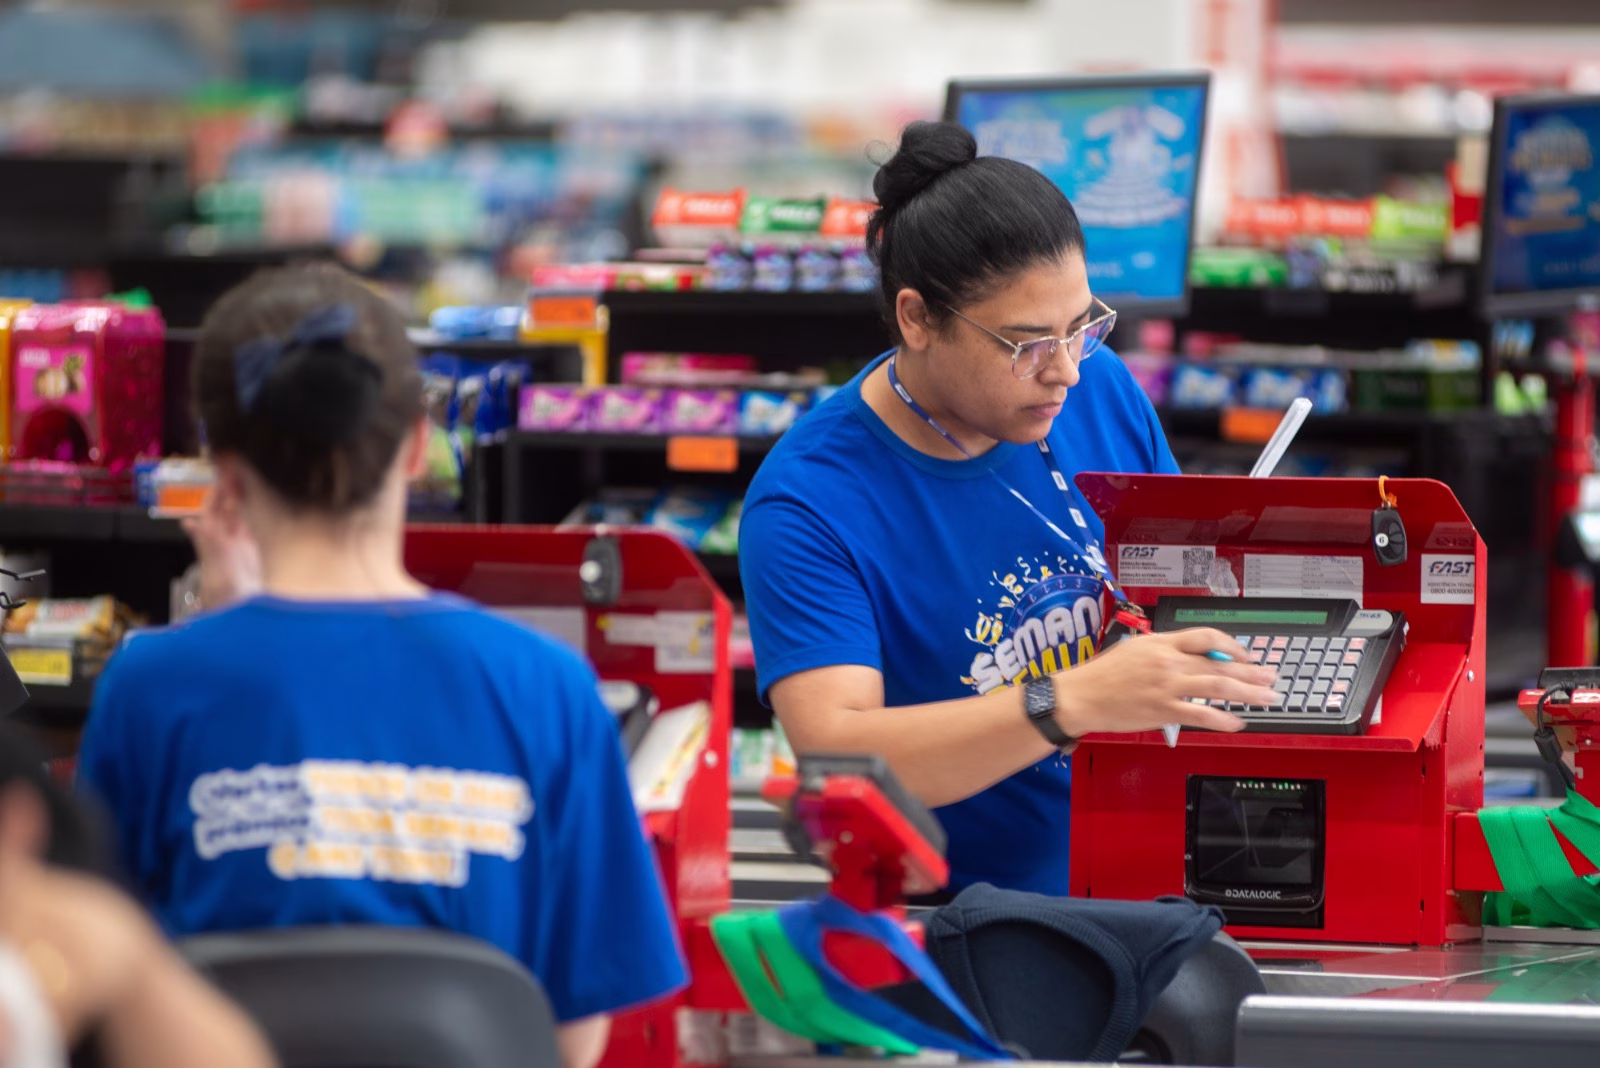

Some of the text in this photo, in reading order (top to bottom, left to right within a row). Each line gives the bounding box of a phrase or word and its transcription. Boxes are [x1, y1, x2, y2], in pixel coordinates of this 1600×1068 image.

[1122, 546, 1159, 557] FAST
[1430, 561, 1475, 574] FAST
[970, 596, 1104, 695] SEMAN
[1232, 889, 1281, 900] DATALOGIC
